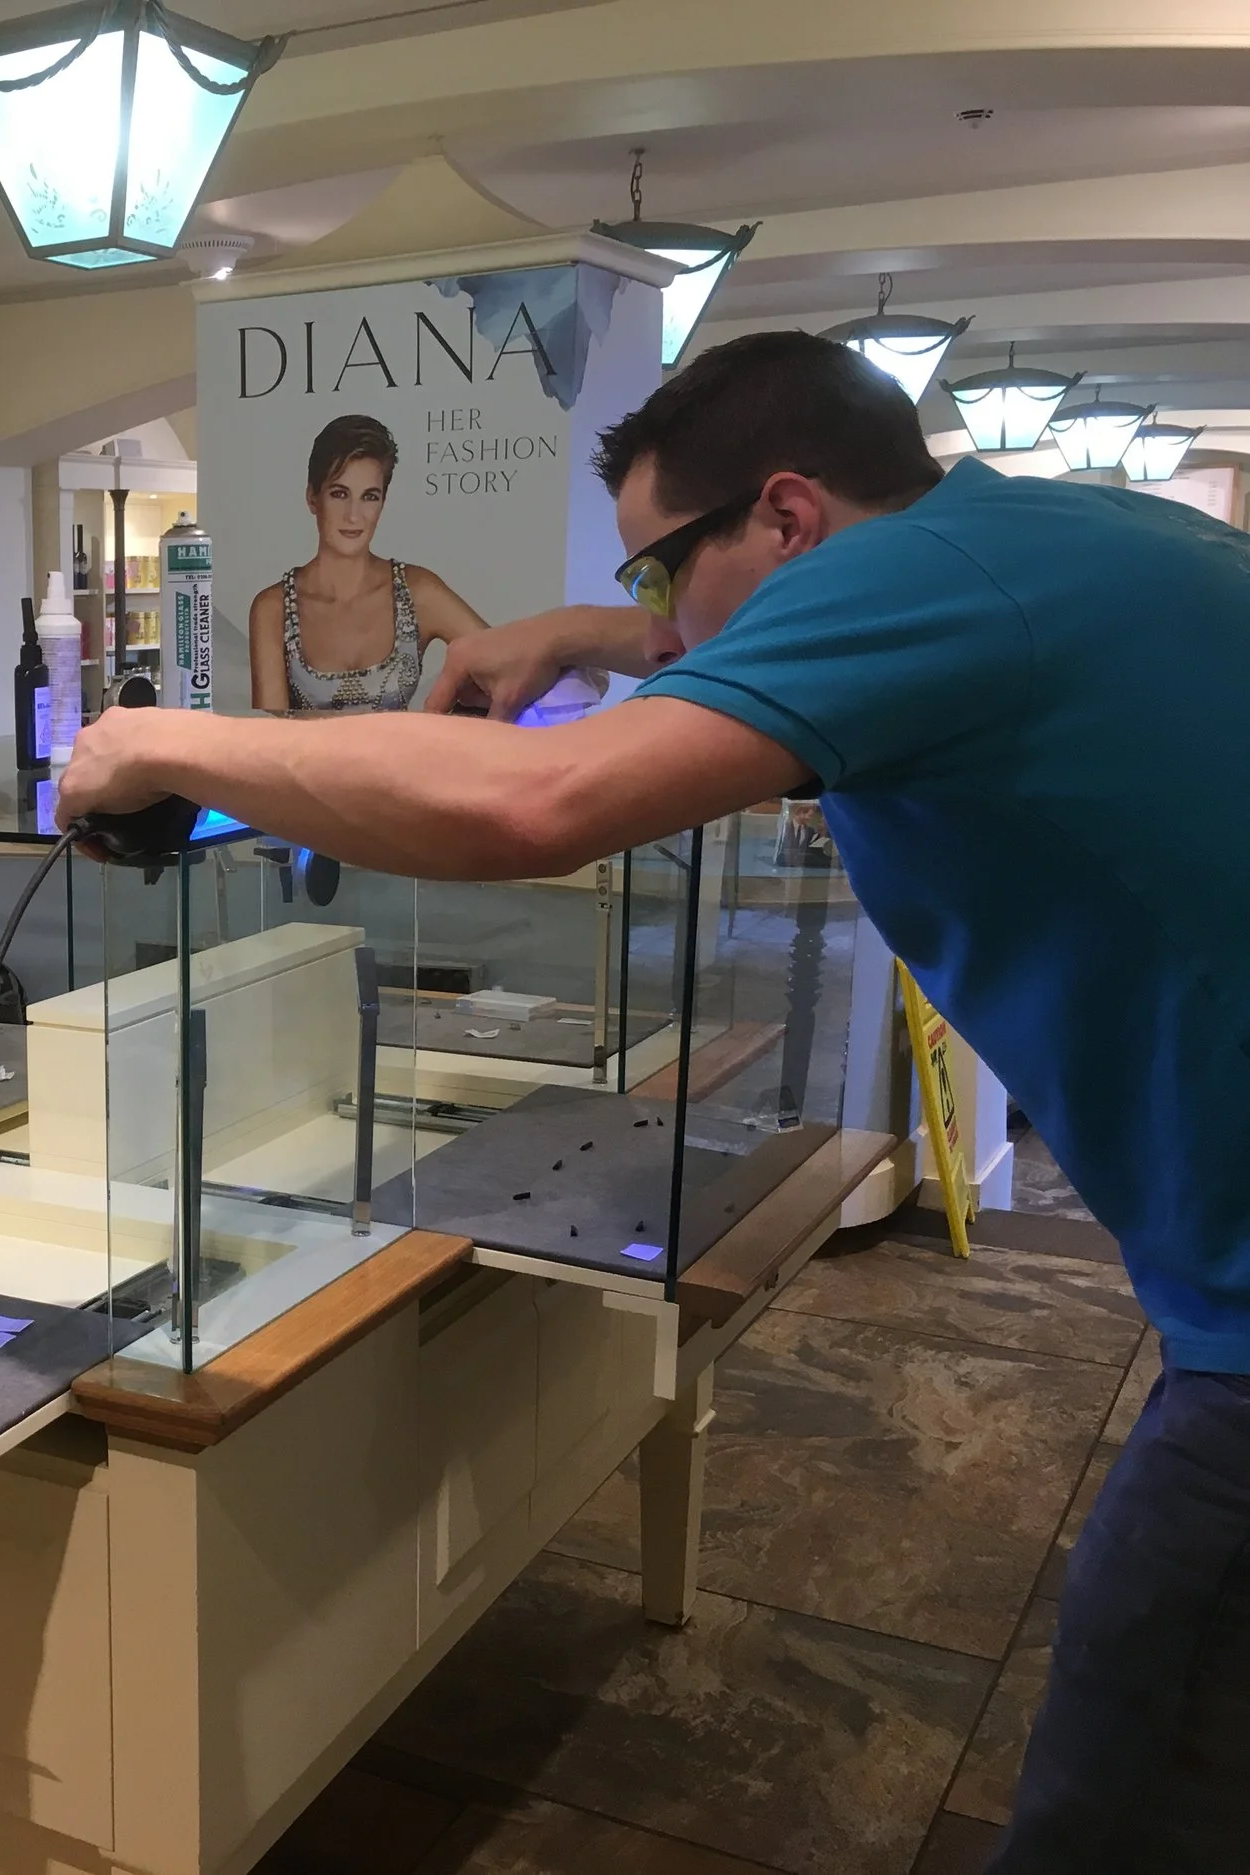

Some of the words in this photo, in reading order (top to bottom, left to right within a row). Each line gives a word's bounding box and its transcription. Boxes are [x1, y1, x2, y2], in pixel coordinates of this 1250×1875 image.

[238, 302, 557, 398] DIANA
[427, 408, 482, 432] HER
[426, 435, 557, 463] FASHION
[425, 469, 518, 495] STORY
[199, 594, 210, 643] CLEANER
[191, 647, 210, 689] GLASS
